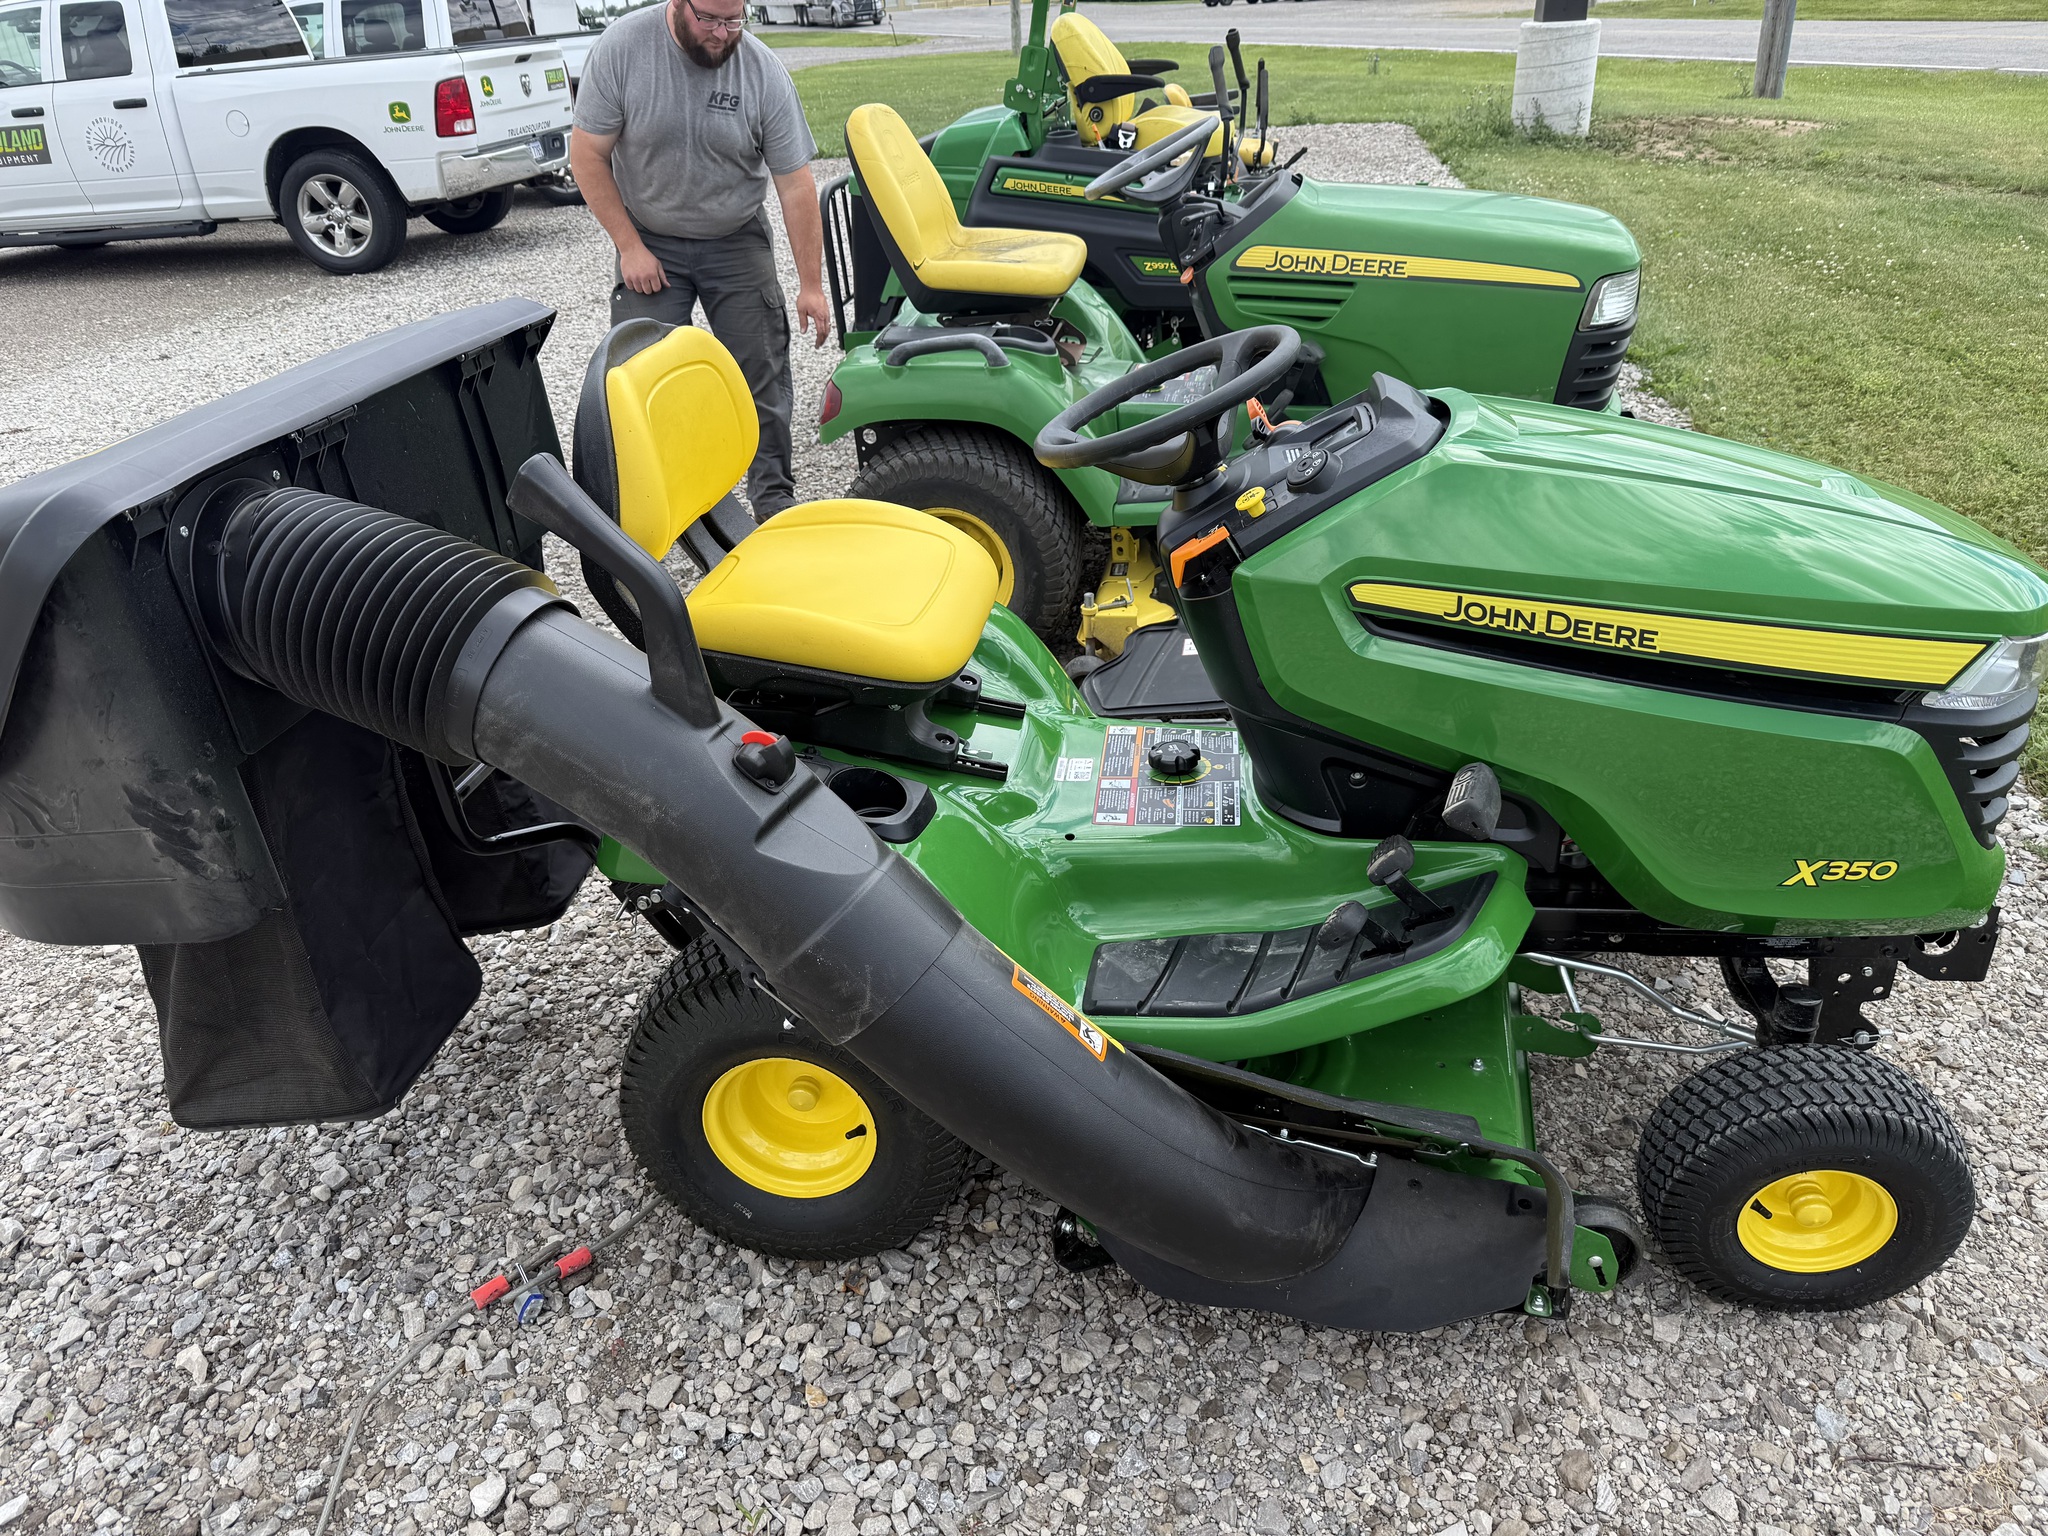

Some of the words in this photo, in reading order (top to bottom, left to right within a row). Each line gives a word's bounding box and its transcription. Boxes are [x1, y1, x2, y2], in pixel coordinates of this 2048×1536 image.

[708, 90, 740, 108] KFG
[383, 125, 402, 134] JOHN
[401, 124, 425, 133] DEERE
[1010, 180, 1037, 191] JOHN
[1039, 182, 1072, 195] DEERE
[1265, 250, 1327, 272] JOHN
[1331, 253, 1408, 276] DEERE
[1443, 595, 1537, 632] JOHN
[1546, 609, 1660, 651] DEERE
[1777, 859, 1900, 888] X350
